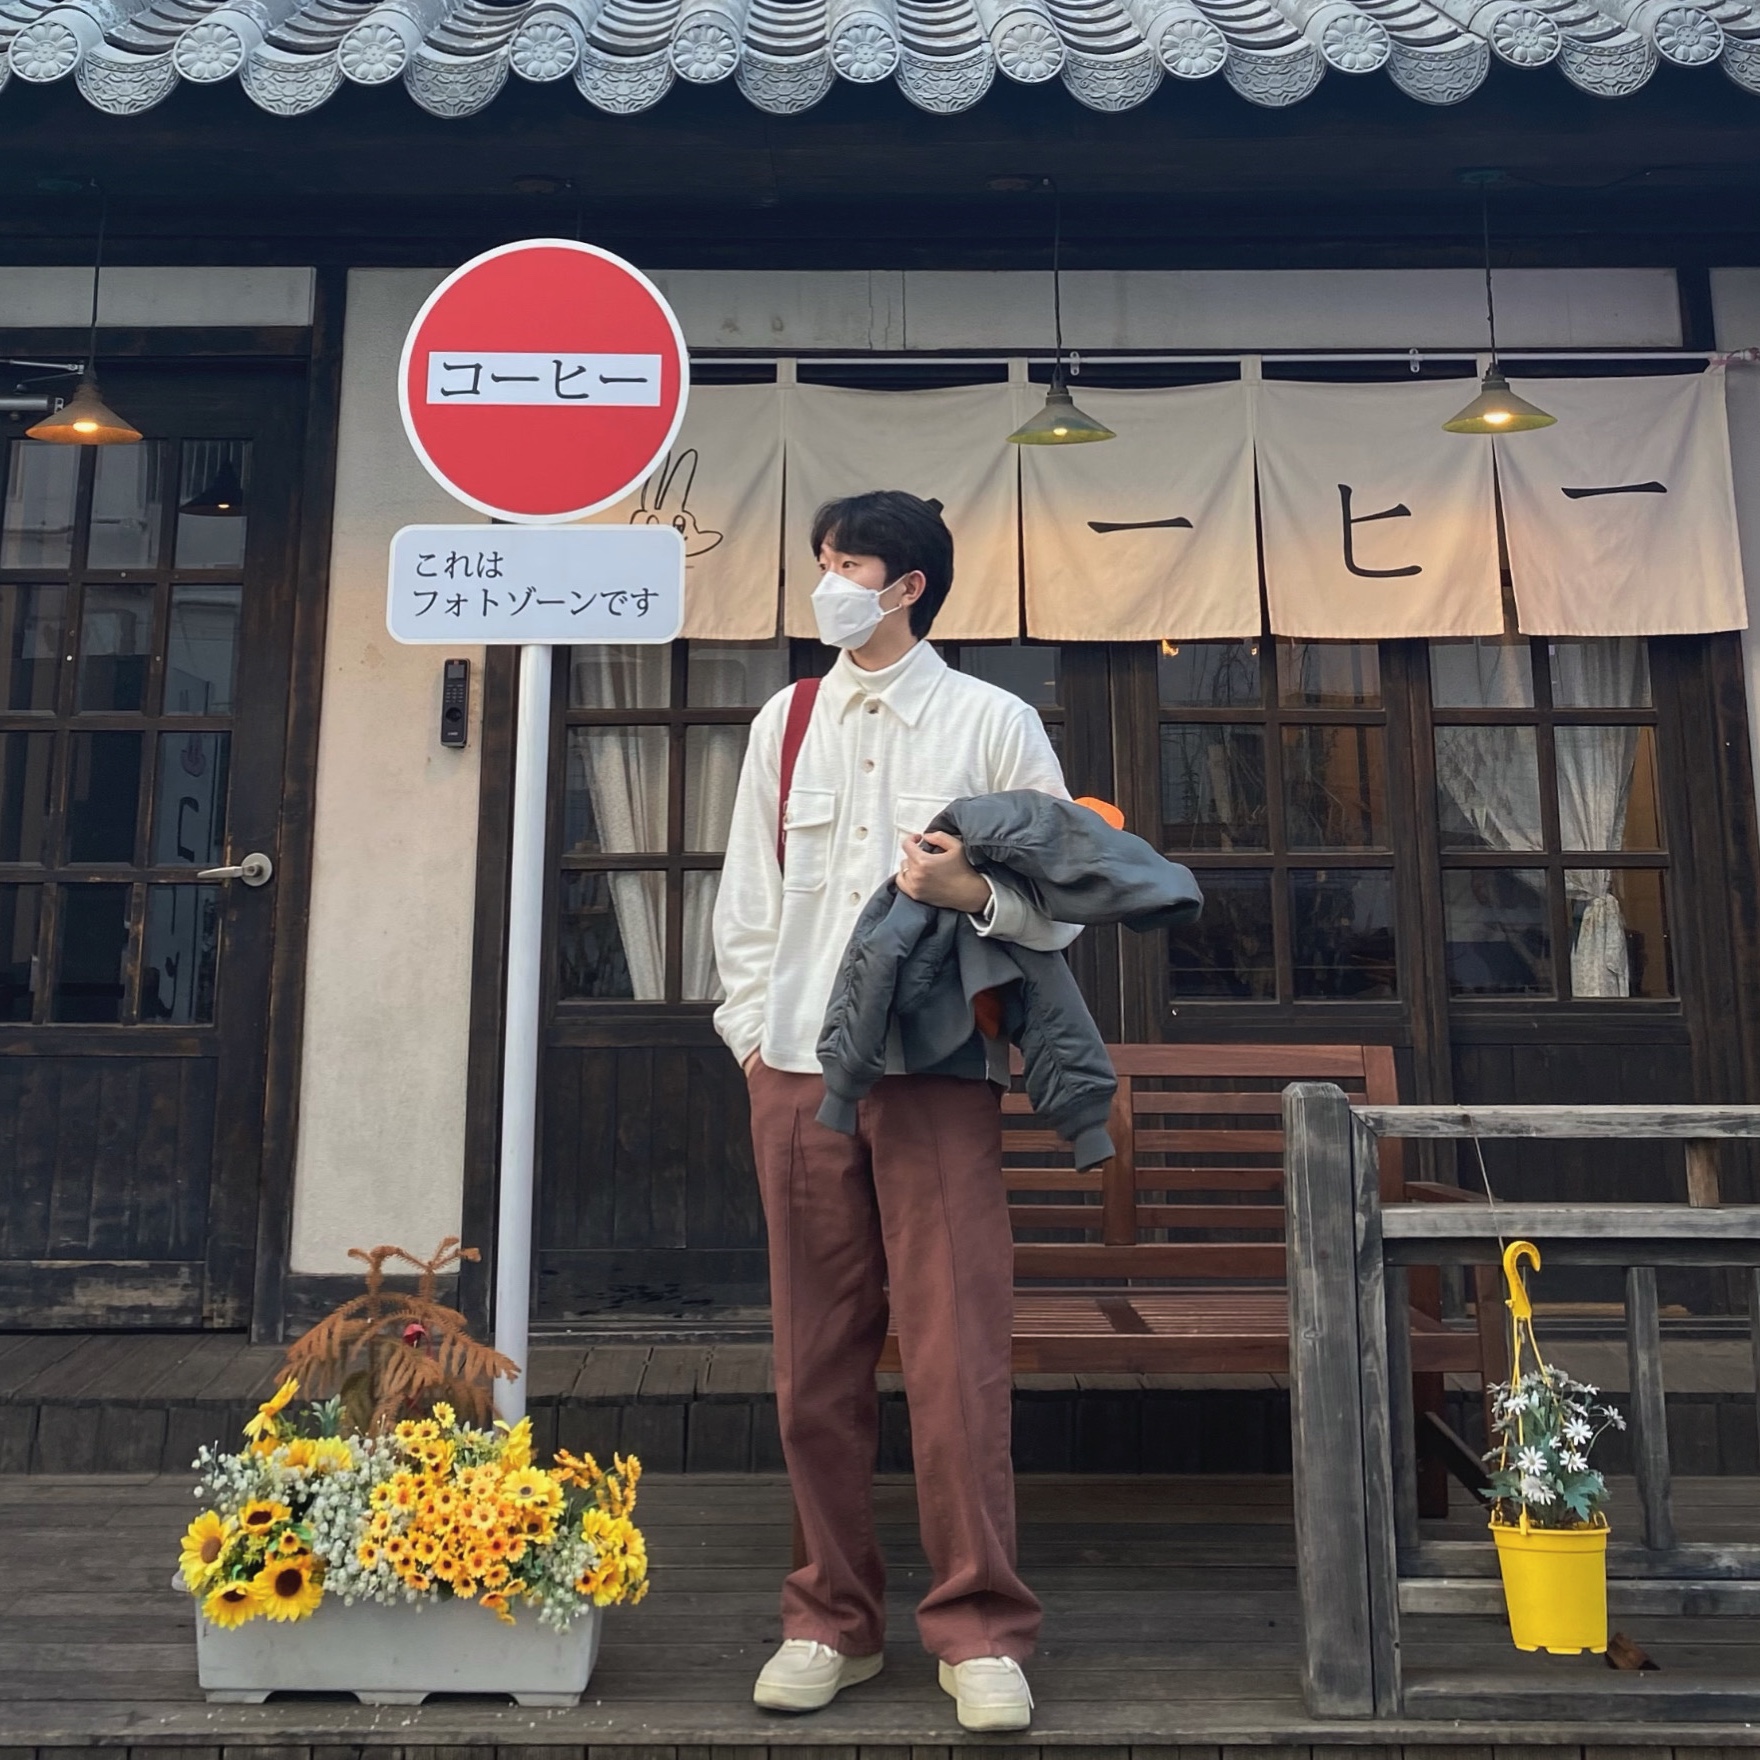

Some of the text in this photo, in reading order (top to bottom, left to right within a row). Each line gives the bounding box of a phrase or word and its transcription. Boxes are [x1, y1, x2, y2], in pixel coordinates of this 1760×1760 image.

[441, 359, 648, 400] コーヒー
[416, 551, 503, 579] これは
[413, 586, 659, 617] フォトゾーンです
